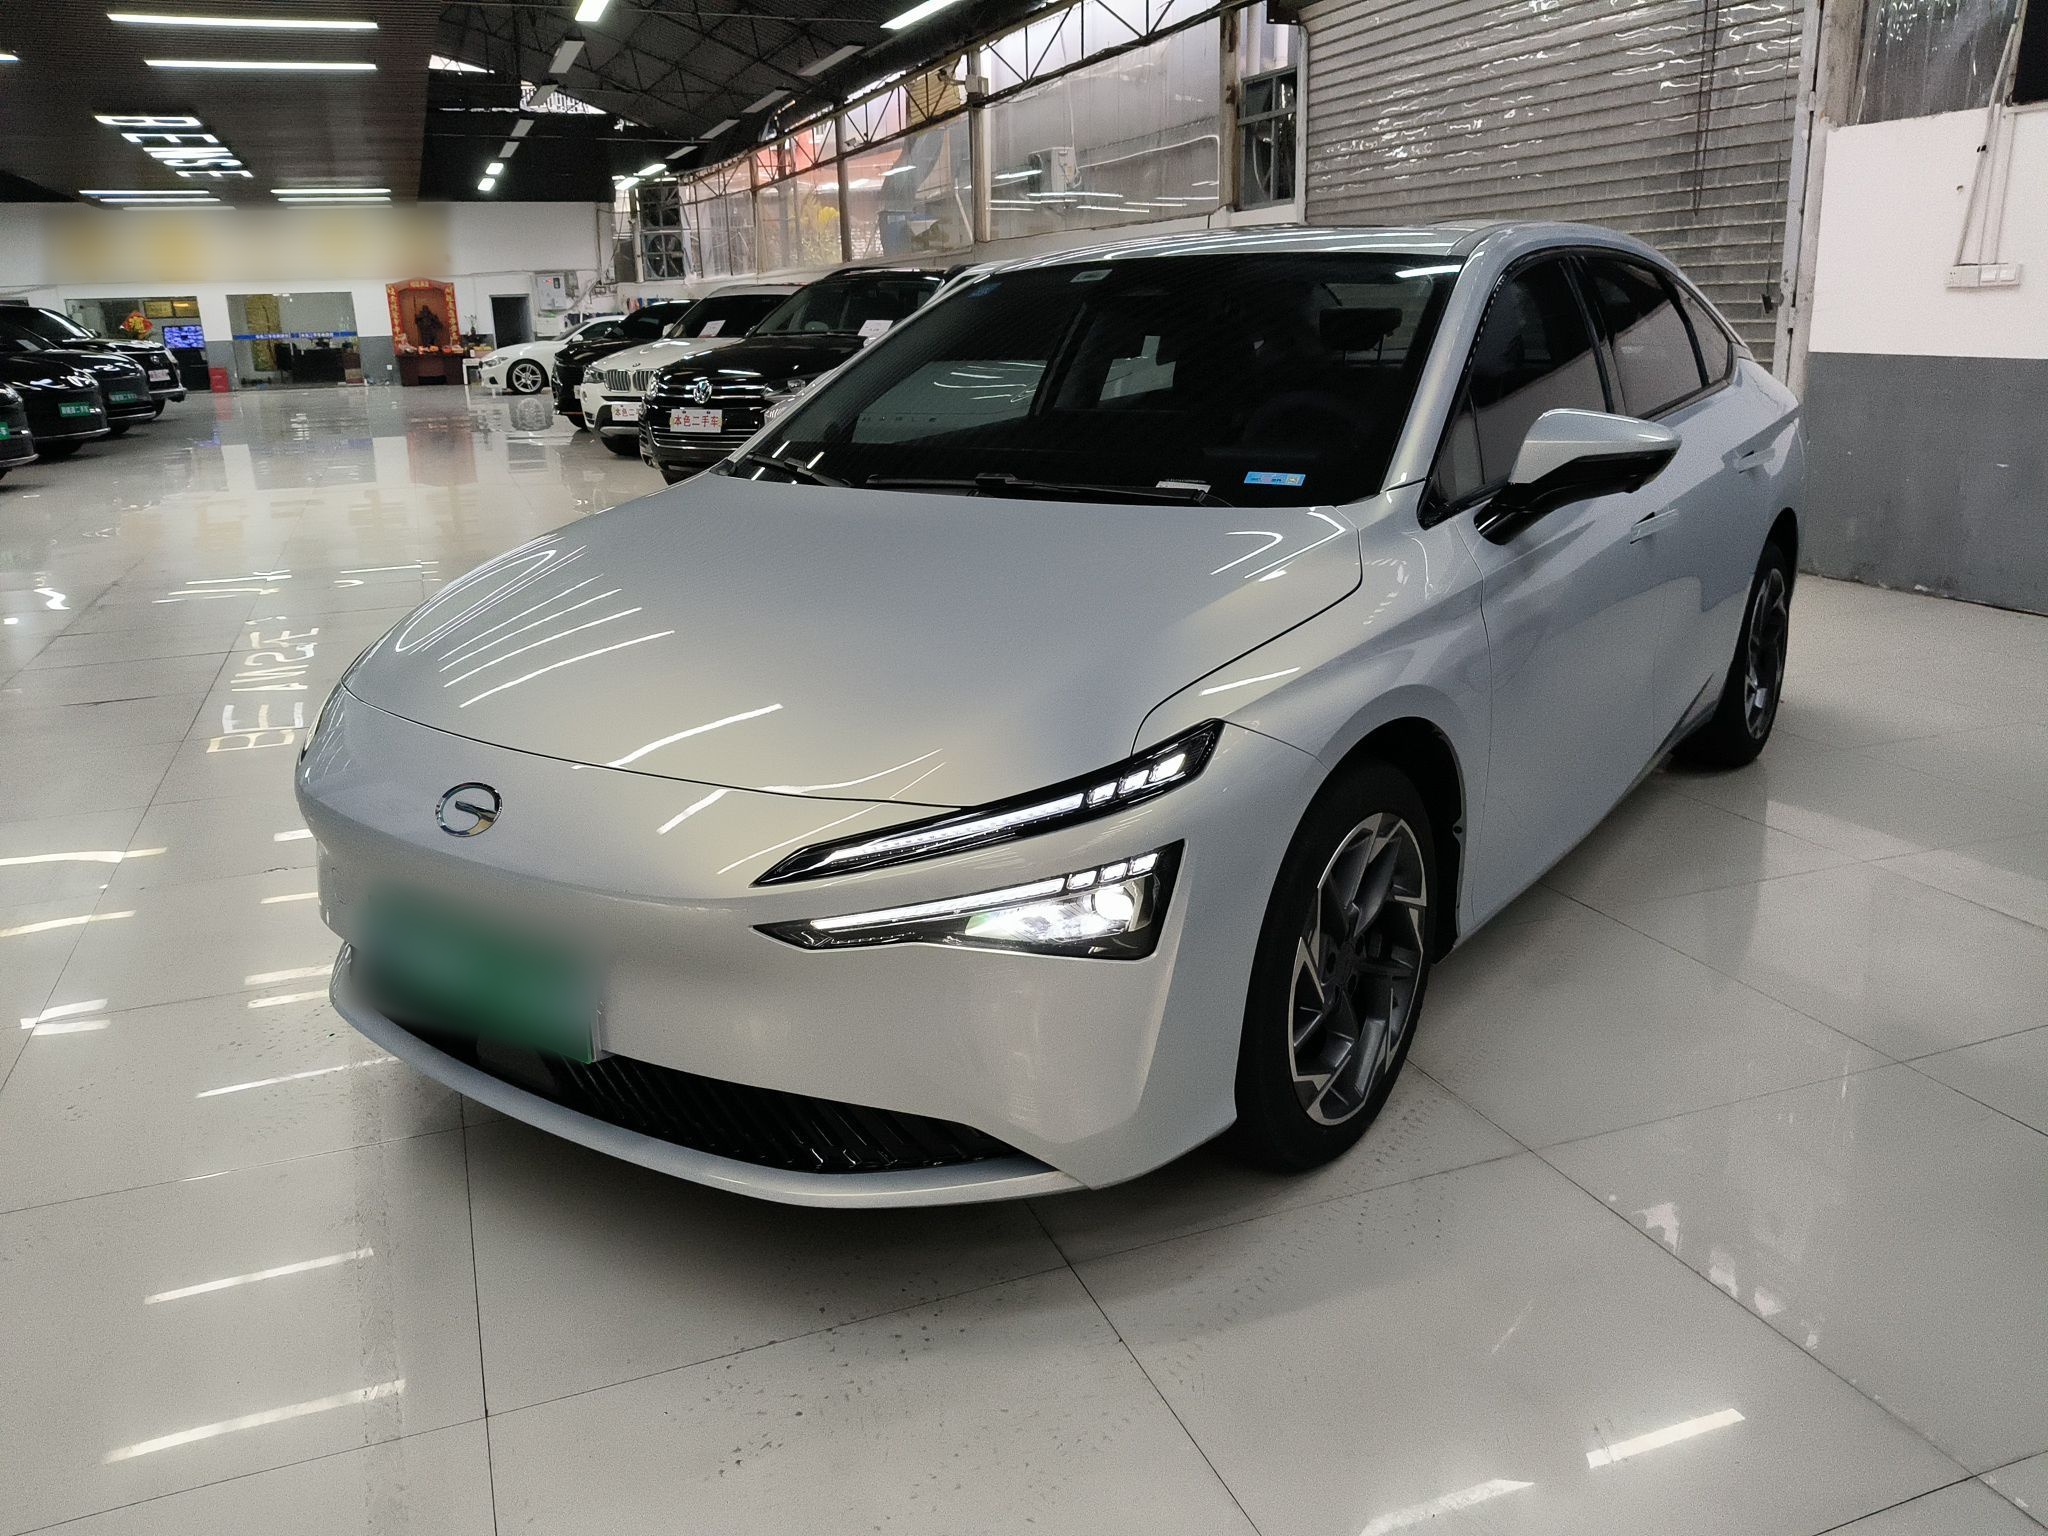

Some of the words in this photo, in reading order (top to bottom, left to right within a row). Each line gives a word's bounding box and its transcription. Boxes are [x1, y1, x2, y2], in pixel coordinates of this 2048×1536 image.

[674, 414, 718, 428] 本色二手车
